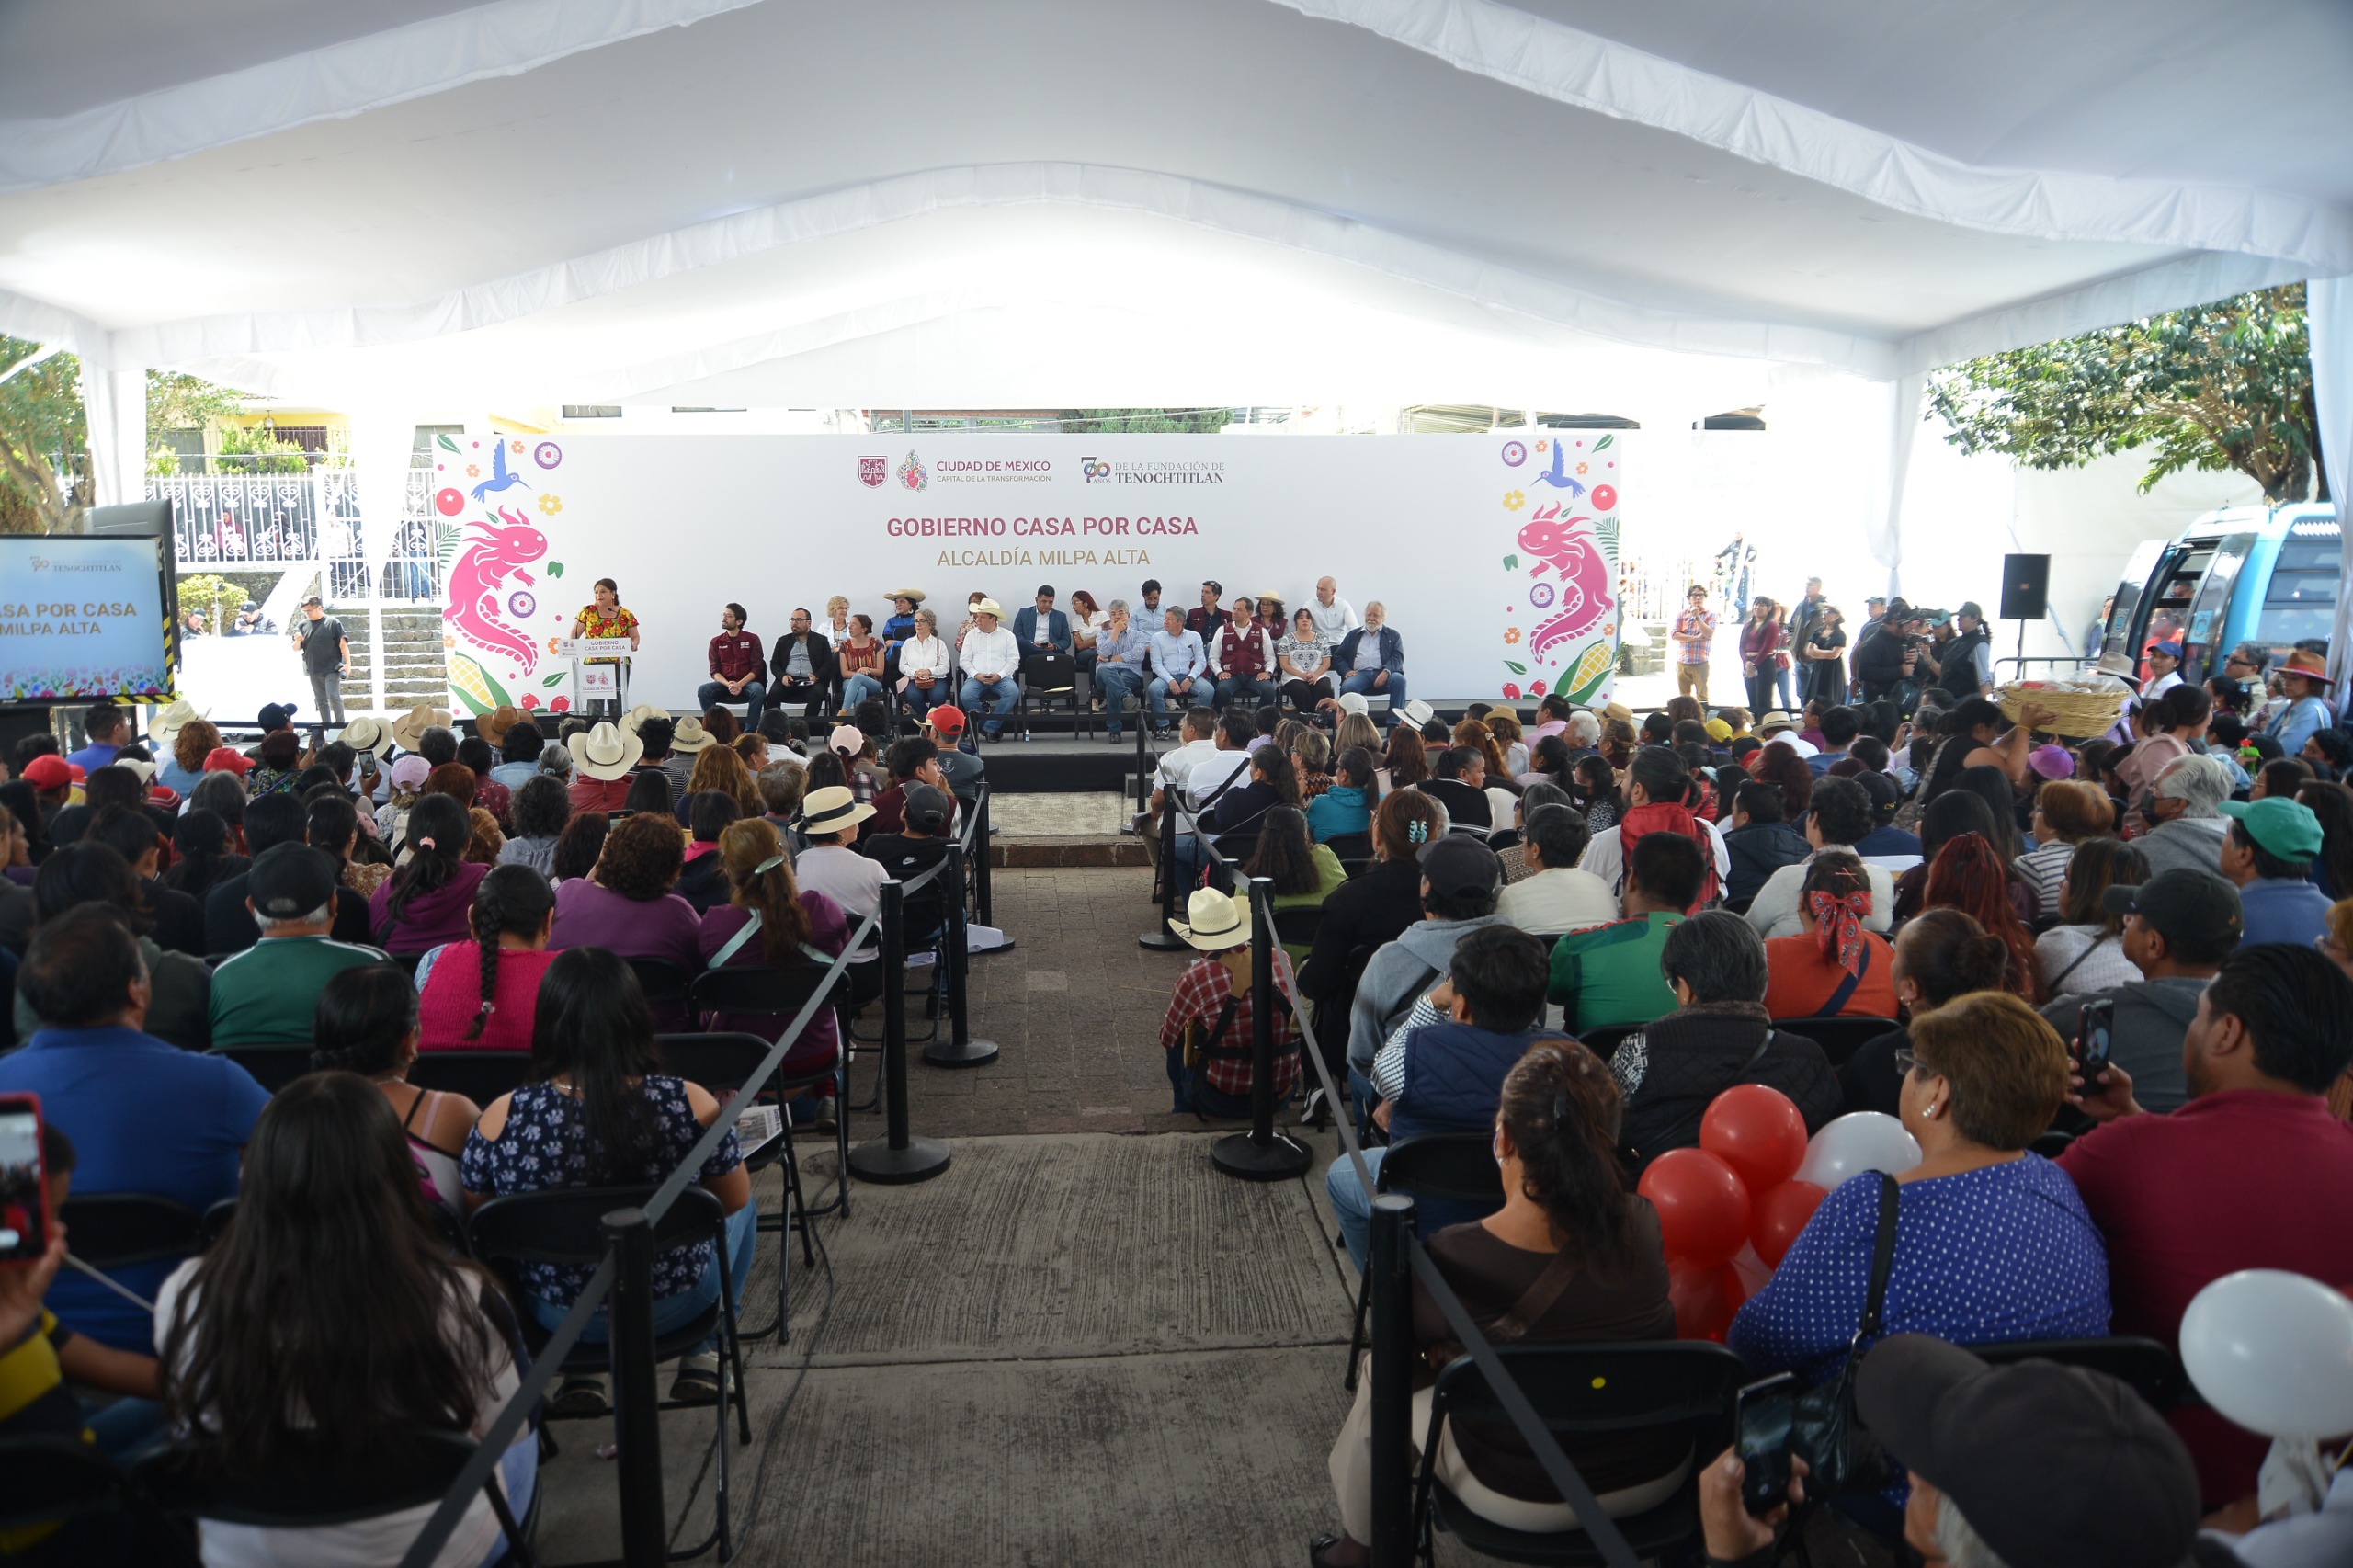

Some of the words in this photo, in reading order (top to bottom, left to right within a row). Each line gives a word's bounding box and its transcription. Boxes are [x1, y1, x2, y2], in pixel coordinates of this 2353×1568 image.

[936, 460, 983, 472] CIUDAD
[985, 460, 1002, 472] DE
[1005, 459, 1051, 471] MÉXICO
[1115, 462, 1129, 471] DE
[1131, 462, 1144, 471] LA
[1147, 461, 1209, 471] FUNDACIÓN
[1211, 461, 1224, 471] DE
[1115, 472, 1224, 483] TENOCHTITLAN
[887, 517, 1006, 537] GOBIERNO
[1013, 517, 1076, 536] CASA
[1083, 517, 1130, 535] POR
[1136, 517, 1199, 535] CASA
[937, 547, 1033, 566] ALCALDÍA
[1039, 550, 1098, 566] MILPA
[1103, 549, 1150, 565] ALTA
[36, 603, 77, 618] POR
[83, 602, 137, 617] CASA
[0, 622, 53, 636] MILPA
[59, 622, 101, 635] ALTA
